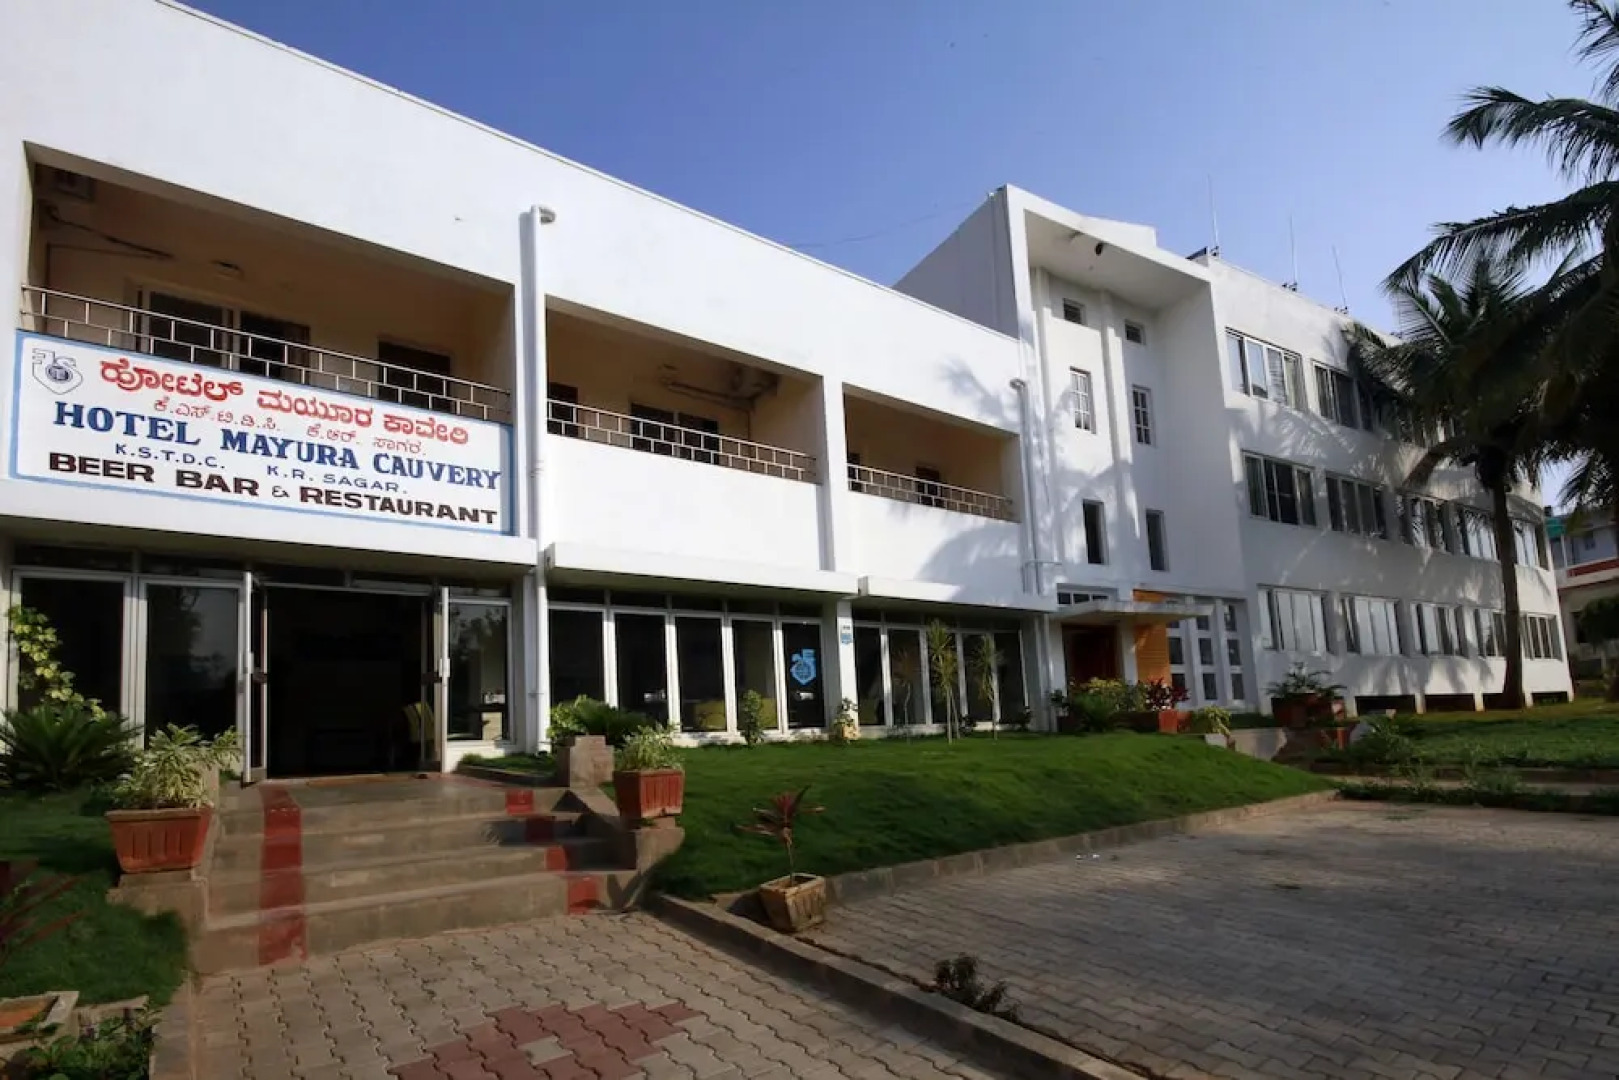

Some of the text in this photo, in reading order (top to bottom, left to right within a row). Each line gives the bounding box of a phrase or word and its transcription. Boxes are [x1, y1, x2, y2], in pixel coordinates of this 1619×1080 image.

[53, 401, 501, 490] HOTEL MAYURA CAUVERY
[257, 389, 373, 428] ಮಯೂರ
[383, 412, 469, 445] ಕಾವೇರಿ
[49, 451, 498, 525] BEER BAR & RESTAURANT
[115, 443, 225, 469] K.S.T.D.C.
